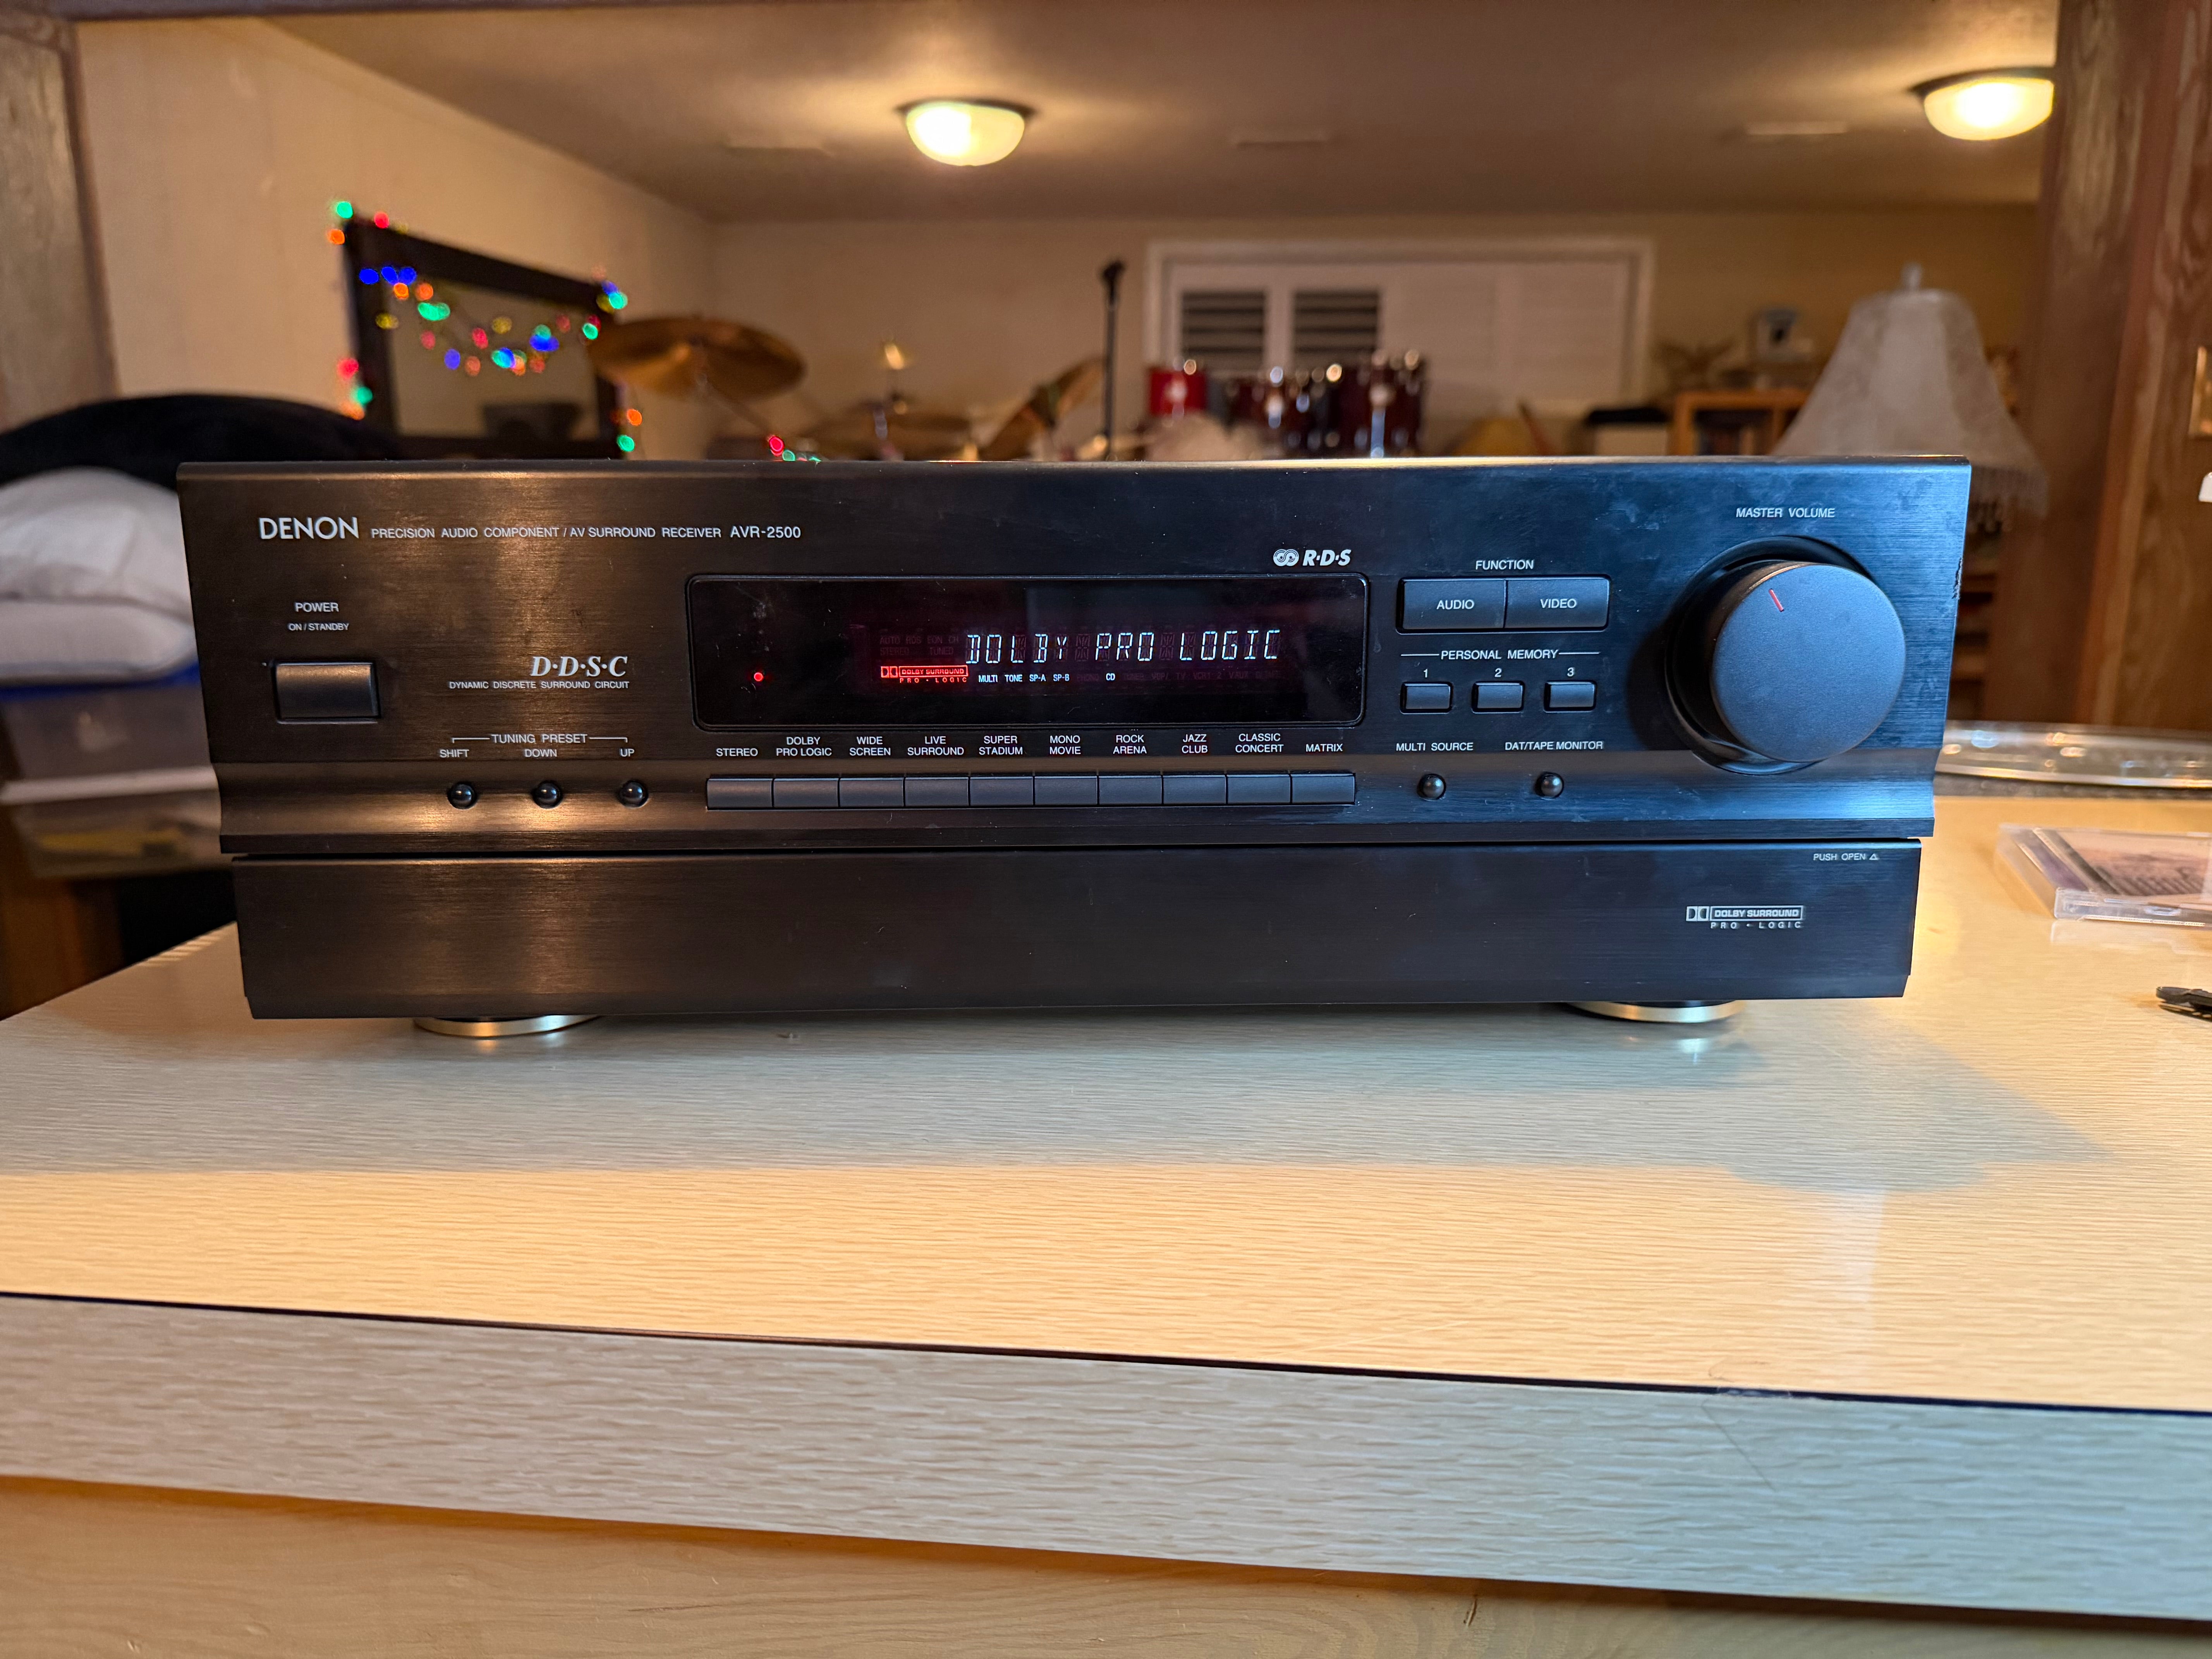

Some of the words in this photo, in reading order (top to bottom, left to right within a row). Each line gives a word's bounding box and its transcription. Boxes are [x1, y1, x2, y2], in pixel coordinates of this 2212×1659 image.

[1736, 507, 1783, 518] MASTER
[1788, 508, 1836, 518] VOLUME
[259, 517, 359, 539] DENON
[372, 528, 435, 538] PRECISION
[441, 527, 478, 538] AUDIO
[484, 527, 560, 538] COMPONENT
[570, 527, 585, 537] AV
[588, 527, 656, 538] SURROUND
[662, 527, 721, 538] RECEIVER
[730, 526, 801, 538] AVR-2500
[1475, 560, 1534, 570] FUNCTION
[295, 602, 339, 612] POWER
[1436, 599, 1475, 610] AUDIO
[1540, 598, 1577, 608] VIDEO
[966, 634, 1067, 664] DOLBY
[1095, 632, 1154, 661] PRO
[1180, 630, 1280, 661] LOGIC
[1441, 650, 1501, 659] PERSONAL
[1507, 649, 1559, 659] MEMORY
[1424, 669, 1428, 678] 1
[1494, 668, 1502, 677] 2
[1567, 667, 1574, 677] 3
[978, 675, 998, 683] MULTI
[491, 734, 536, 744] TUNING
[542, 733, 587, 743] PRESET
[787, 737, 820, 745] DOLBY
[857, 736, 883, 745] WIDE
[925, 736, 946, 744] LIVE
[984, 735, 1017, 744] SUPER
[1050, 735, 1080, 744] MONO
[1116, 735, 1144, 743] ROCK
[1183, 734, 1207, 742] JAZZ
[1238, 733, 1280, 742] CLASSIC
[1113, 746, 1147, 754] ARENA
[1182, 745, 1208, 754] CLUB
[1235, 744, 1284, 753] CONCERT
[1306, 744, 1343, 752] MATRIX
[1396, 743, 1425, 751] MULTI
[1431, 742, 1474, 751] SOURCE
[1505, 741, 1554, 750] DAT/TAPE
[1556, 741, 1603, 750] MONITOR
[440, 749, 469, 758] SHIFT
[524, 749, 557, 757] DOWN
[620, 749, 635, 757] UP
[716, 748, 758, 757] STEREO
[776, 748, 799, 756] PRO
[800, 747, 832, 756] LOGIC
[850, 747, 891, 756] SCREEN
[907, 747, 964, 756] SURROUND
[979, 747, 1023, 755] STADIUM
[1049, 746, 1081, 755] MOVIE
[1747, 909, 1800, 917] SURROUND
